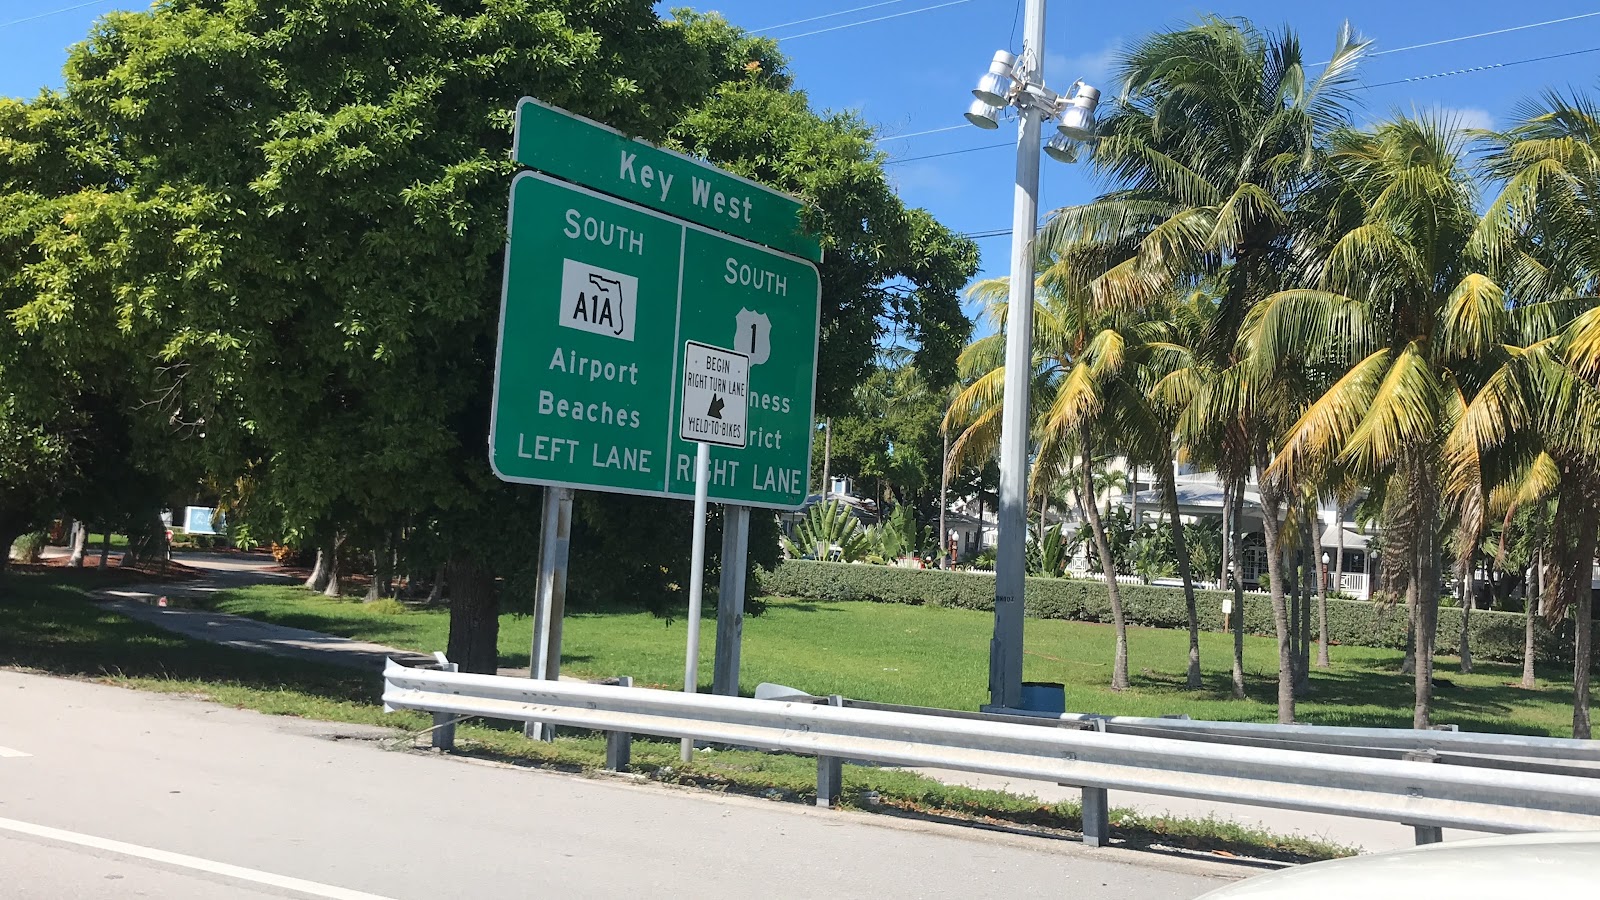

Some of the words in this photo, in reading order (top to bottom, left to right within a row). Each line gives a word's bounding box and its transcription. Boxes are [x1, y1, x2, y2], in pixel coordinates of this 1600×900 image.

[619, 150, 674, 202] Key
[691, 176, 753, 224] West
[563, 208, 644, 255] SOUTH
[723, 257, 788, 297] SOUTH
[573, 291, 613, 328] A1A
[750, 323, 757, 354] 1
[549, 347, 639, 385] Airport
[706, 355, 731, 374] BEGIN
[687, 371, 708, 390] RIGHT
[709, 376, 727, 393] TURN
[728, 380, 745, 397] LANE
[749, 391, 791, 414] ness
[538, 390, 641, 429] Beaches
[517, 433, 580, 464] LEFT
[592, 443, 652, 474] LANE
[749, 426, 782, 450] rict
[752, 463, 802, 495] LANE
